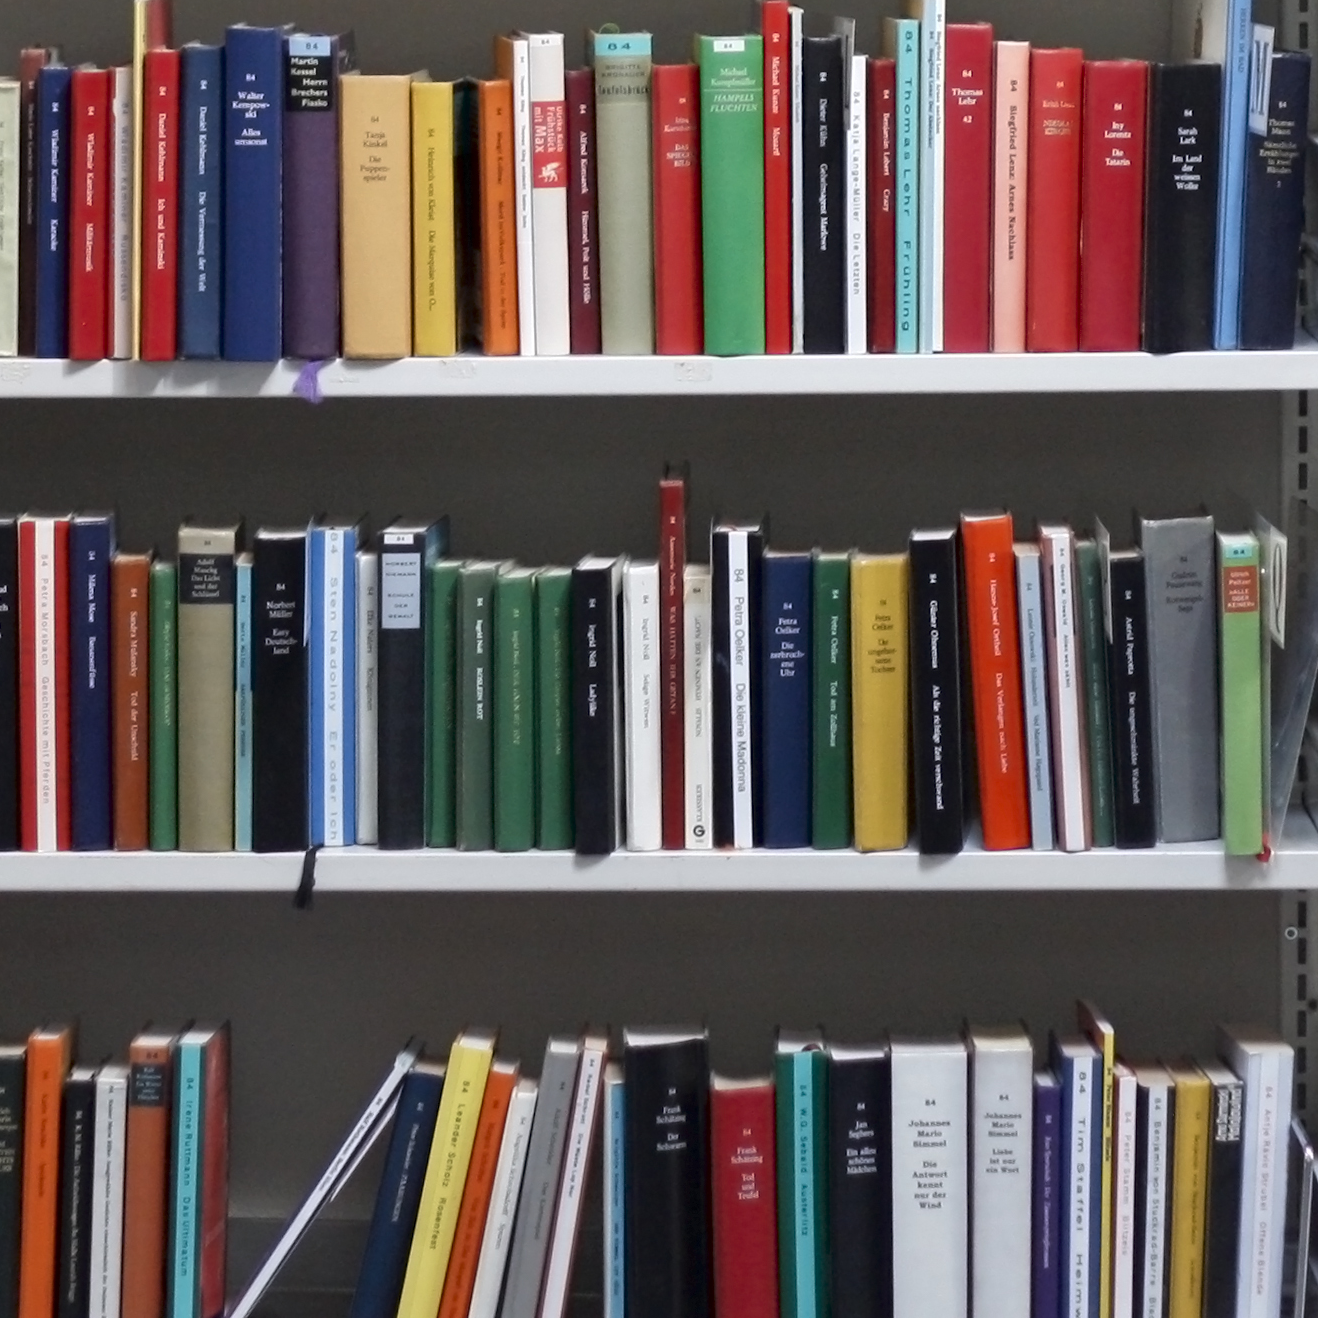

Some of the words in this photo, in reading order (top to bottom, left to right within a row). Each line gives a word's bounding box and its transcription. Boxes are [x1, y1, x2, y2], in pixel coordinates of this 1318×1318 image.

[533, 106, 543, 123] mit
[545, 106, 556, 153] Frühstück
[851, 115, 861, 144] Katja
[1007, 105, 1018, 150] Siegfried
[534, 125, 546, 153] Max
[851, 149, 862, 222] Lange-Müller
[902, 169, 912, 216] Lehr
[900, 241, 912, 332] Frühling
[733, 568, 745, 583] 84
[734, 596, 745, 626] Petra
[735, 629, 746, 666] Oelker
[328, 630, 339, 711] Nadolny
[736, 683, 747, 702] Die
[41, 676, 51, 736] Geschichte
[736, 705, 747, 738] kleine
[737, 741, 747, 792] Madonna
[1075, 1163, 1086, 1232] Staffel
